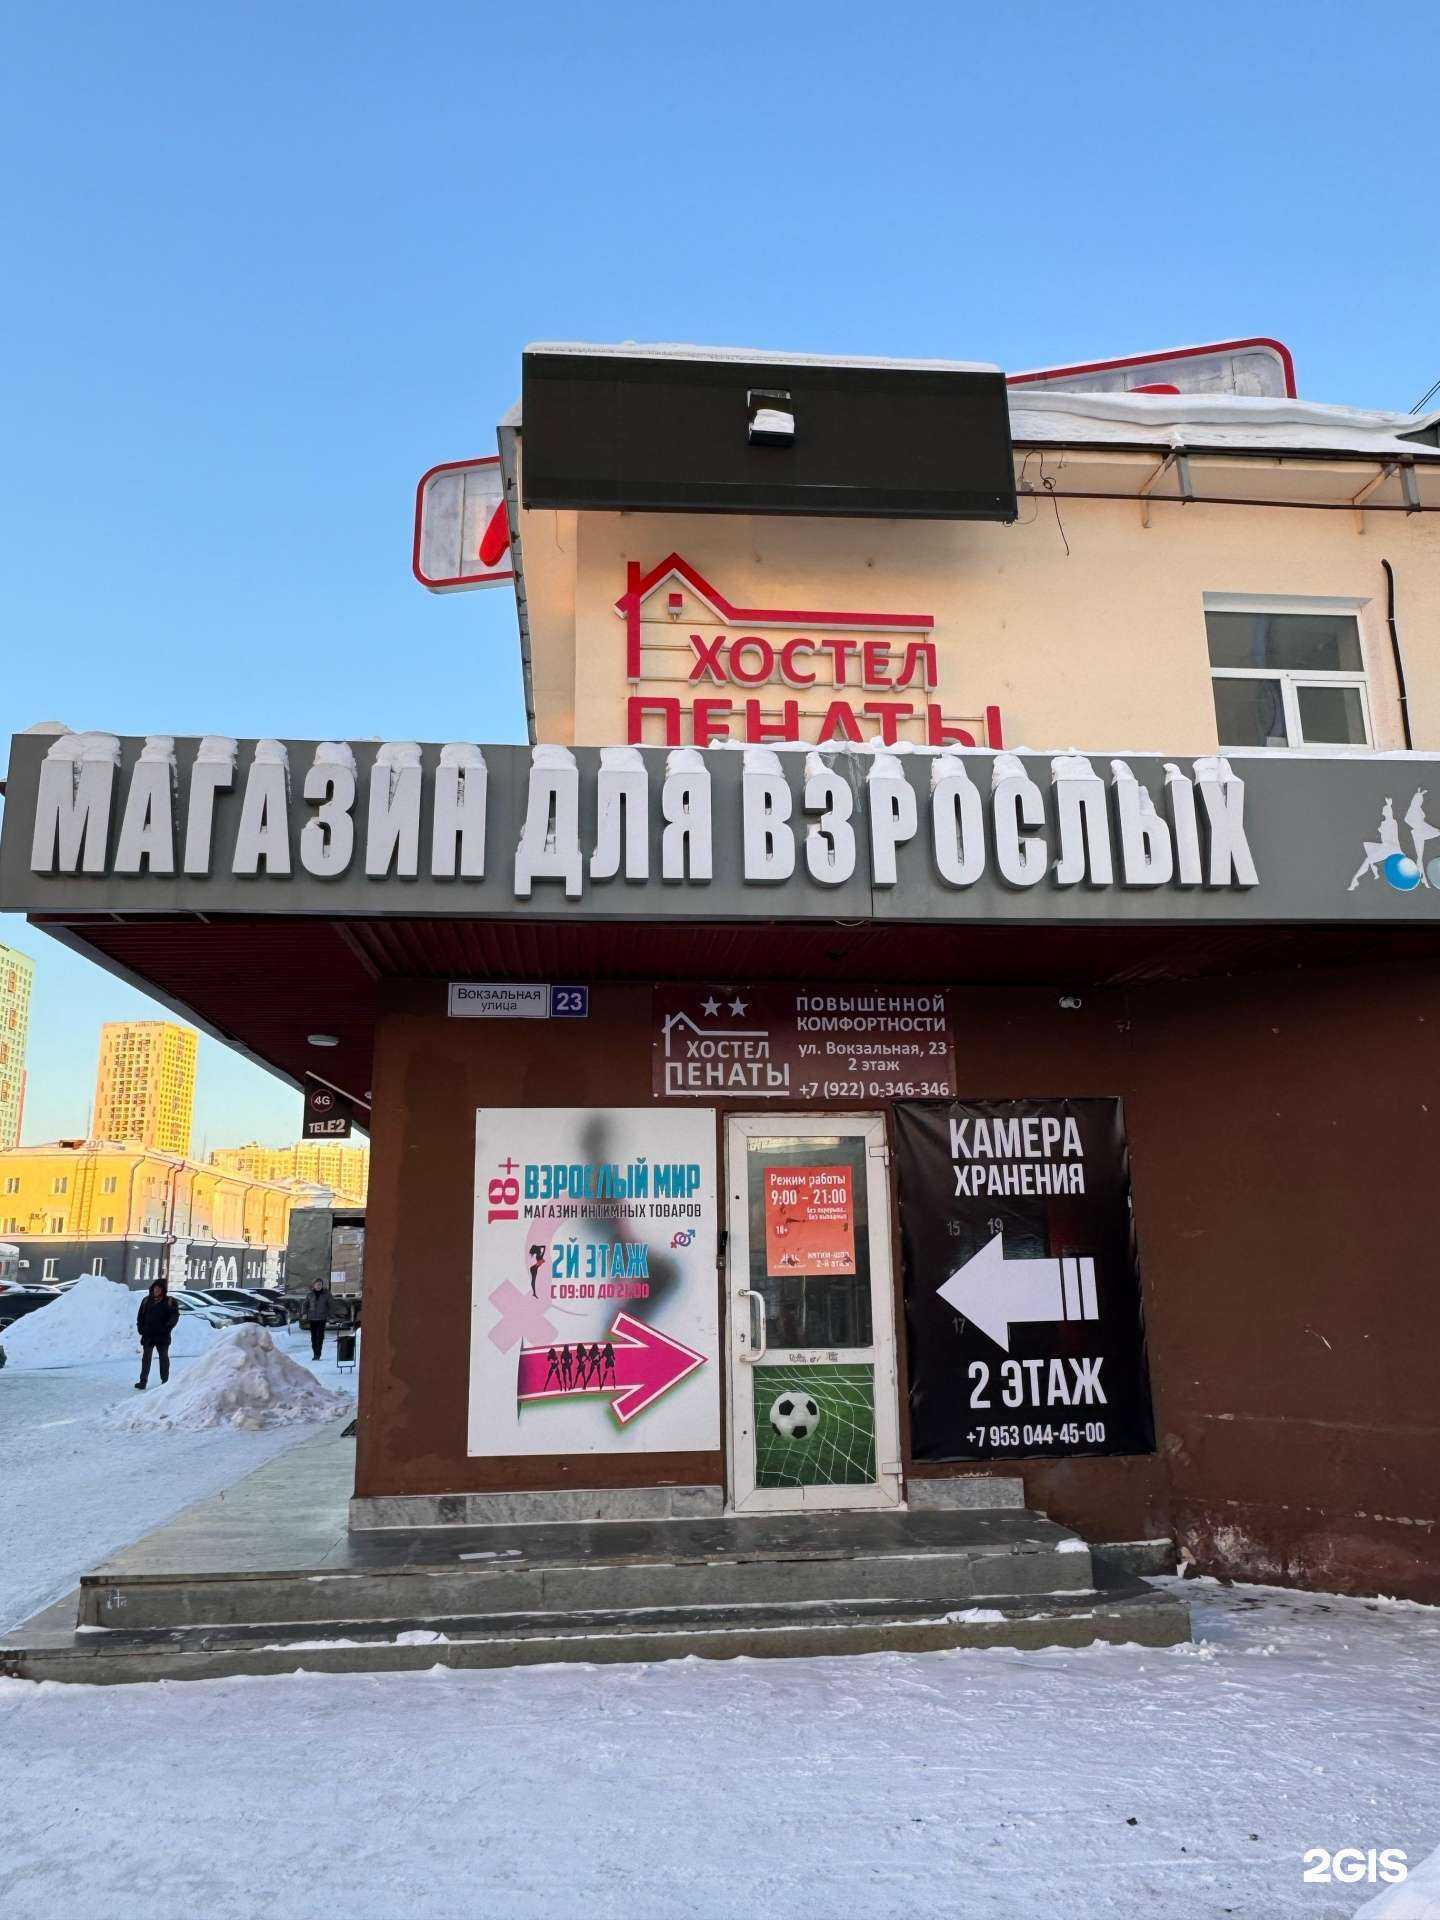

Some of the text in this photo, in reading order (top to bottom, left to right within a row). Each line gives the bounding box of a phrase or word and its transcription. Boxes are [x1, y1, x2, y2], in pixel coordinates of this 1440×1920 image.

[689, 634, 938, 691] ХОСТЕЛ
[628, 696, 1004, 749] ПЕНАТЫ
[30, 758, 1260, 900] МАГАЗИН ДЛЯ ВЗРОСЛЫХ
[481, 1002, 518, 1012] улица
[556, 992, 583, 1011] 23
[796, 994, 945, 1012] ПОВЫШЕННОЙ
[797, 1016, 946, 1032] КОМФОРТНОСТИ
[686, 1041, 770, 1058] ХОСТЕЛ
[799, 1042, 947, 1060] ул. Вокзальная, 23
[848, 1058, 900, 1071] 2 этаж
[666, 1062, 790, 1086] ПЕНАТЫ
[799, 1081, 949, 1098] +7 (922) 0-346-346
[308, 1118, 346, 1134] TELE2
[949, 1117, 1084, 1158] КАМЕРА
[524, 1157, 701, 1200] ВЗРОСЛЫЙ МИР
[770, 1173, 846, 1188] Режим работы
[953, 1164, 1085, 1196] ХРАНЕНИЯ
[488, 1157, 520, 1224] 18+
[771, 1189, 798, 1205] 9:00
[813, 1188, 847, 1204] 21:00
[524, 1205, 578, 1218] МАГАЗИН
[648, 1204, 702, 1218] ТОВАРОВ
[586, 1243, 649, 1279] ЭТАЖ
[560, 1284, 595, 1299] 09:00
[598, 1283, 615, 1299] ДО
[968, 1357, 1108, 1409] 2 ЭТАЖ
[966, 1422, 1105, 1447] +7 953 044-45-00
